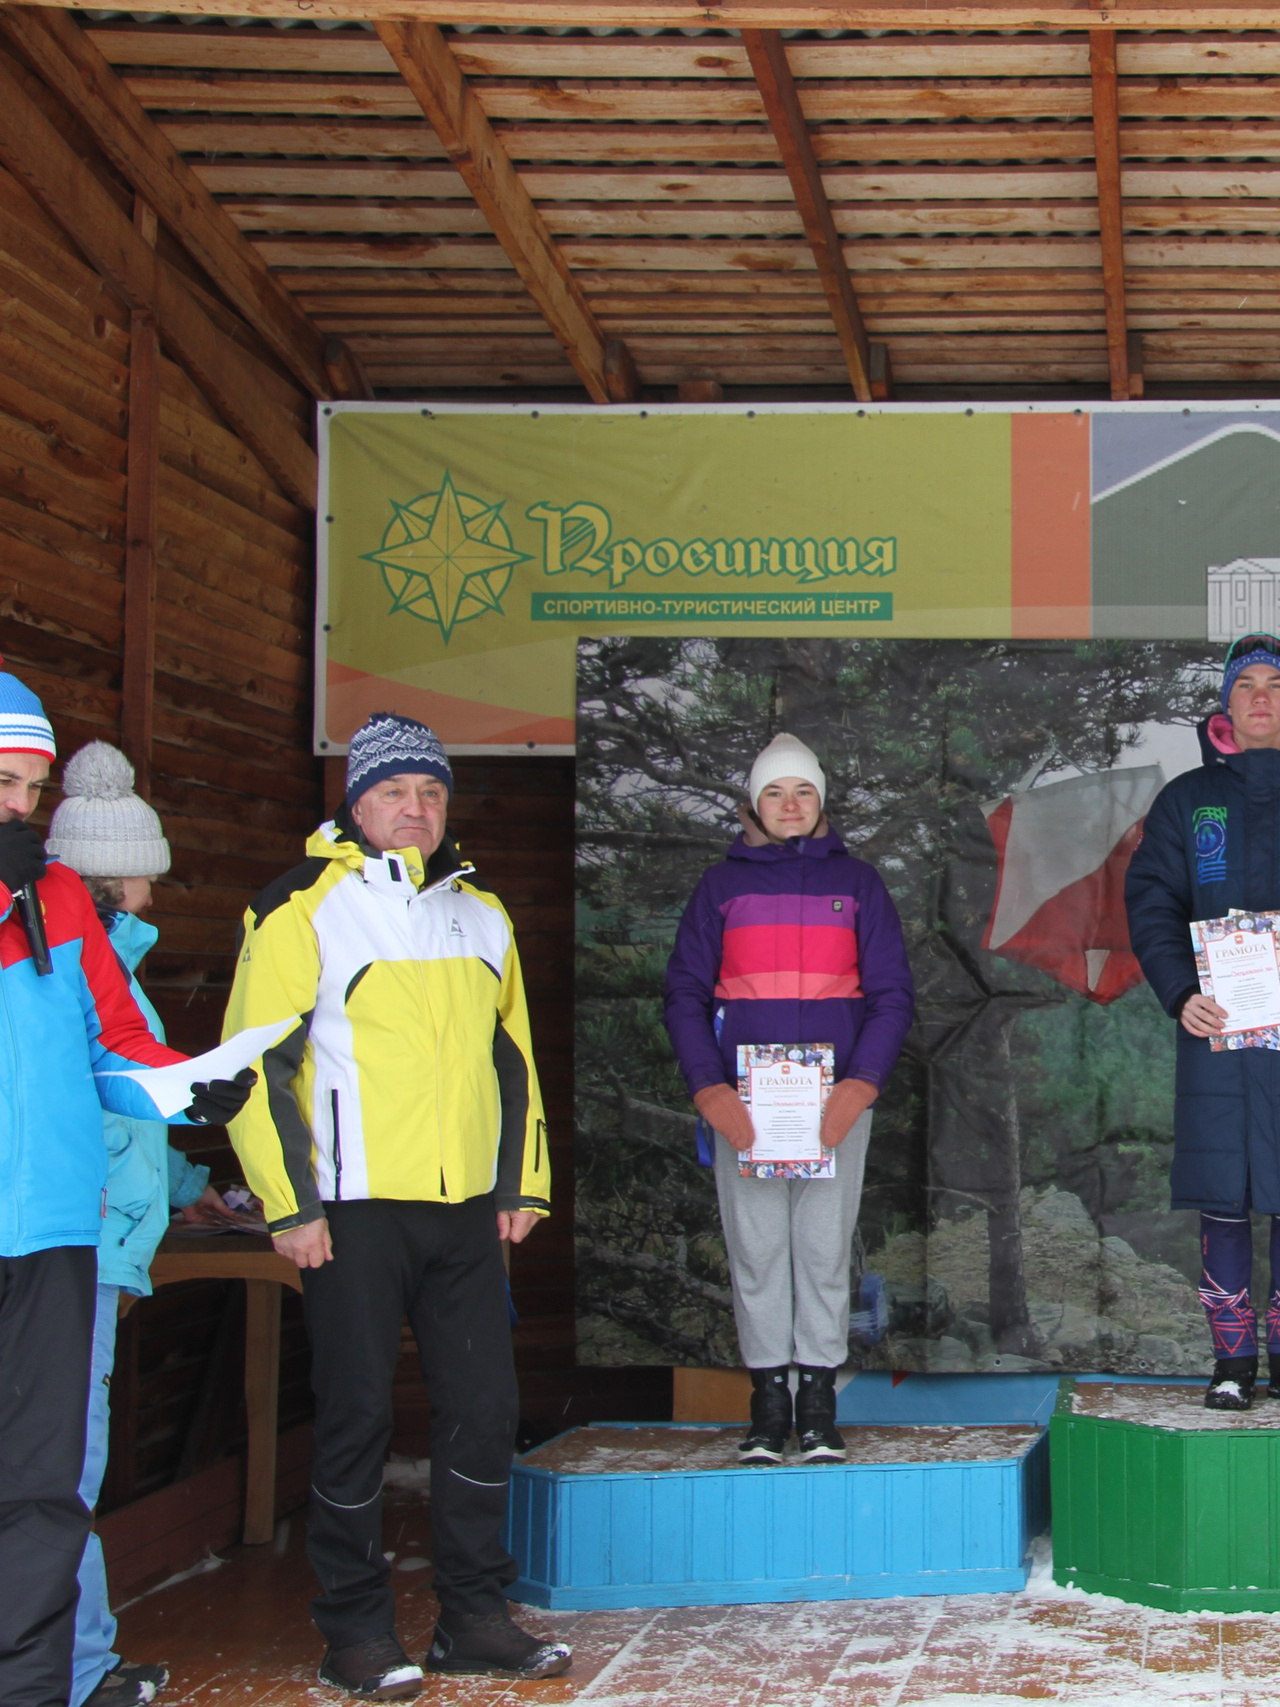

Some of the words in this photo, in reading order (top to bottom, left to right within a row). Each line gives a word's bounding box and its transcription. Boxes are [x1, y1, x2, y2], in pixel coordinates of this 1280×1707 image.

[526, 500, 897, 589] Провинция
[543, 598, 816, 615] СПОРТИВНО-ТУРИСТИЧЕСКИЙ
[821, 600, 880, 617] ЦЕНТР
[1215, 944, 1268, 959] ГРАМОТА
[758, 1076, 813, 1086] ГРАМОТА
